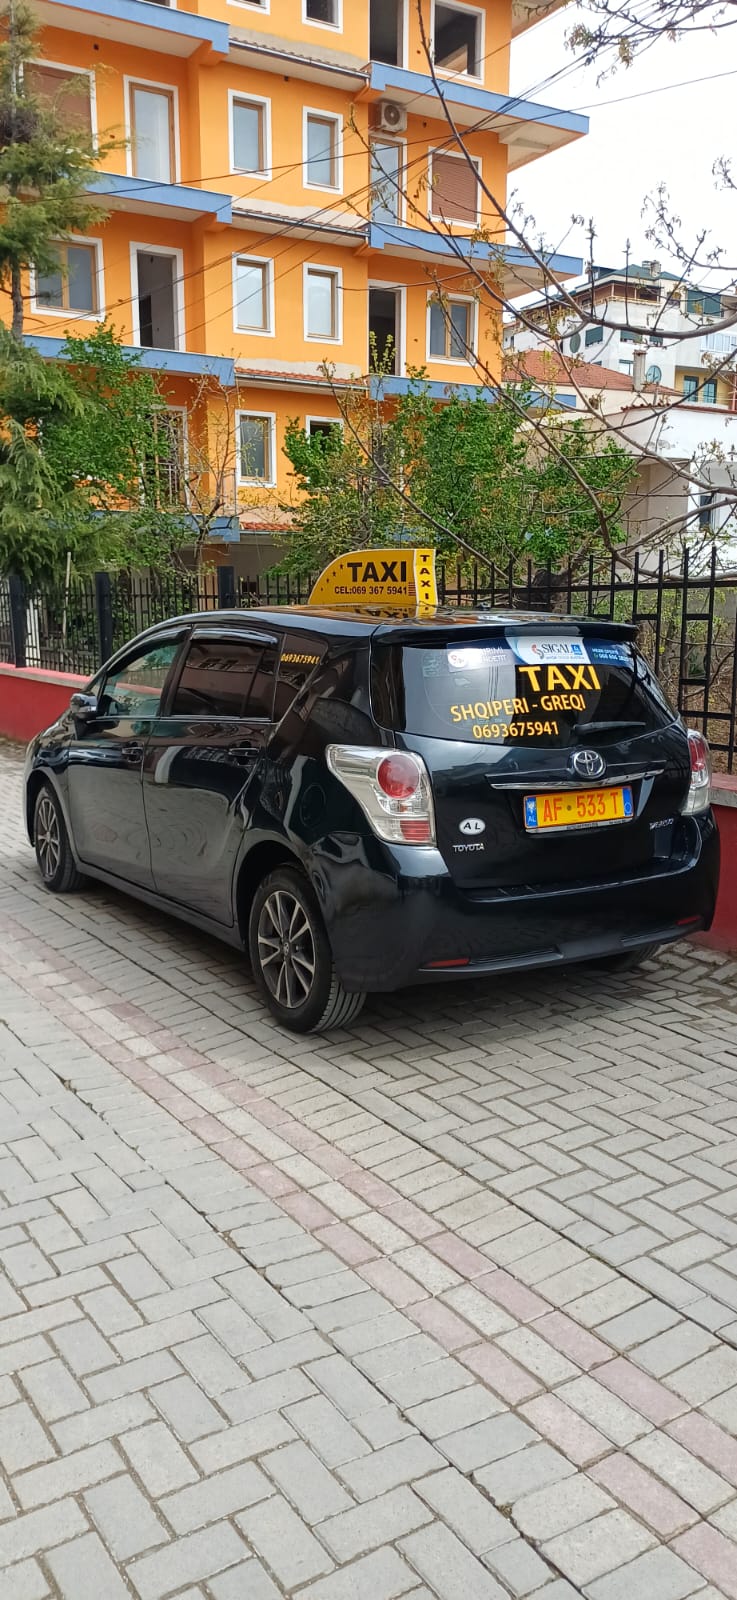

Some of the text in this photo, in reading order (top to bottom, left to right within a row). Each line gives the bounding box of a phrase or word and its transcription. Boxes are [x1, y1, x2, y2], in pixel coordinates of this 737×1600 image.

[347, 561, 407, 582] TAXI
[420, 554, 431, 600] TAXI
[334, 585, 407, 595] CEL:069 367 5941
[541, 643, 574, 654] SIGAL
[518, 665, 602, 692] TAXI
[450, 697, 530, 723] SHQIPERI
[540, 694, 586, 712] GREQI
[472, 721, 559, 739] 0693675941
[543, 791, 619, 822] AF 533 T
[528, 815, 536, 823] AL
[452, 843, 485, 852] TOYOTA
